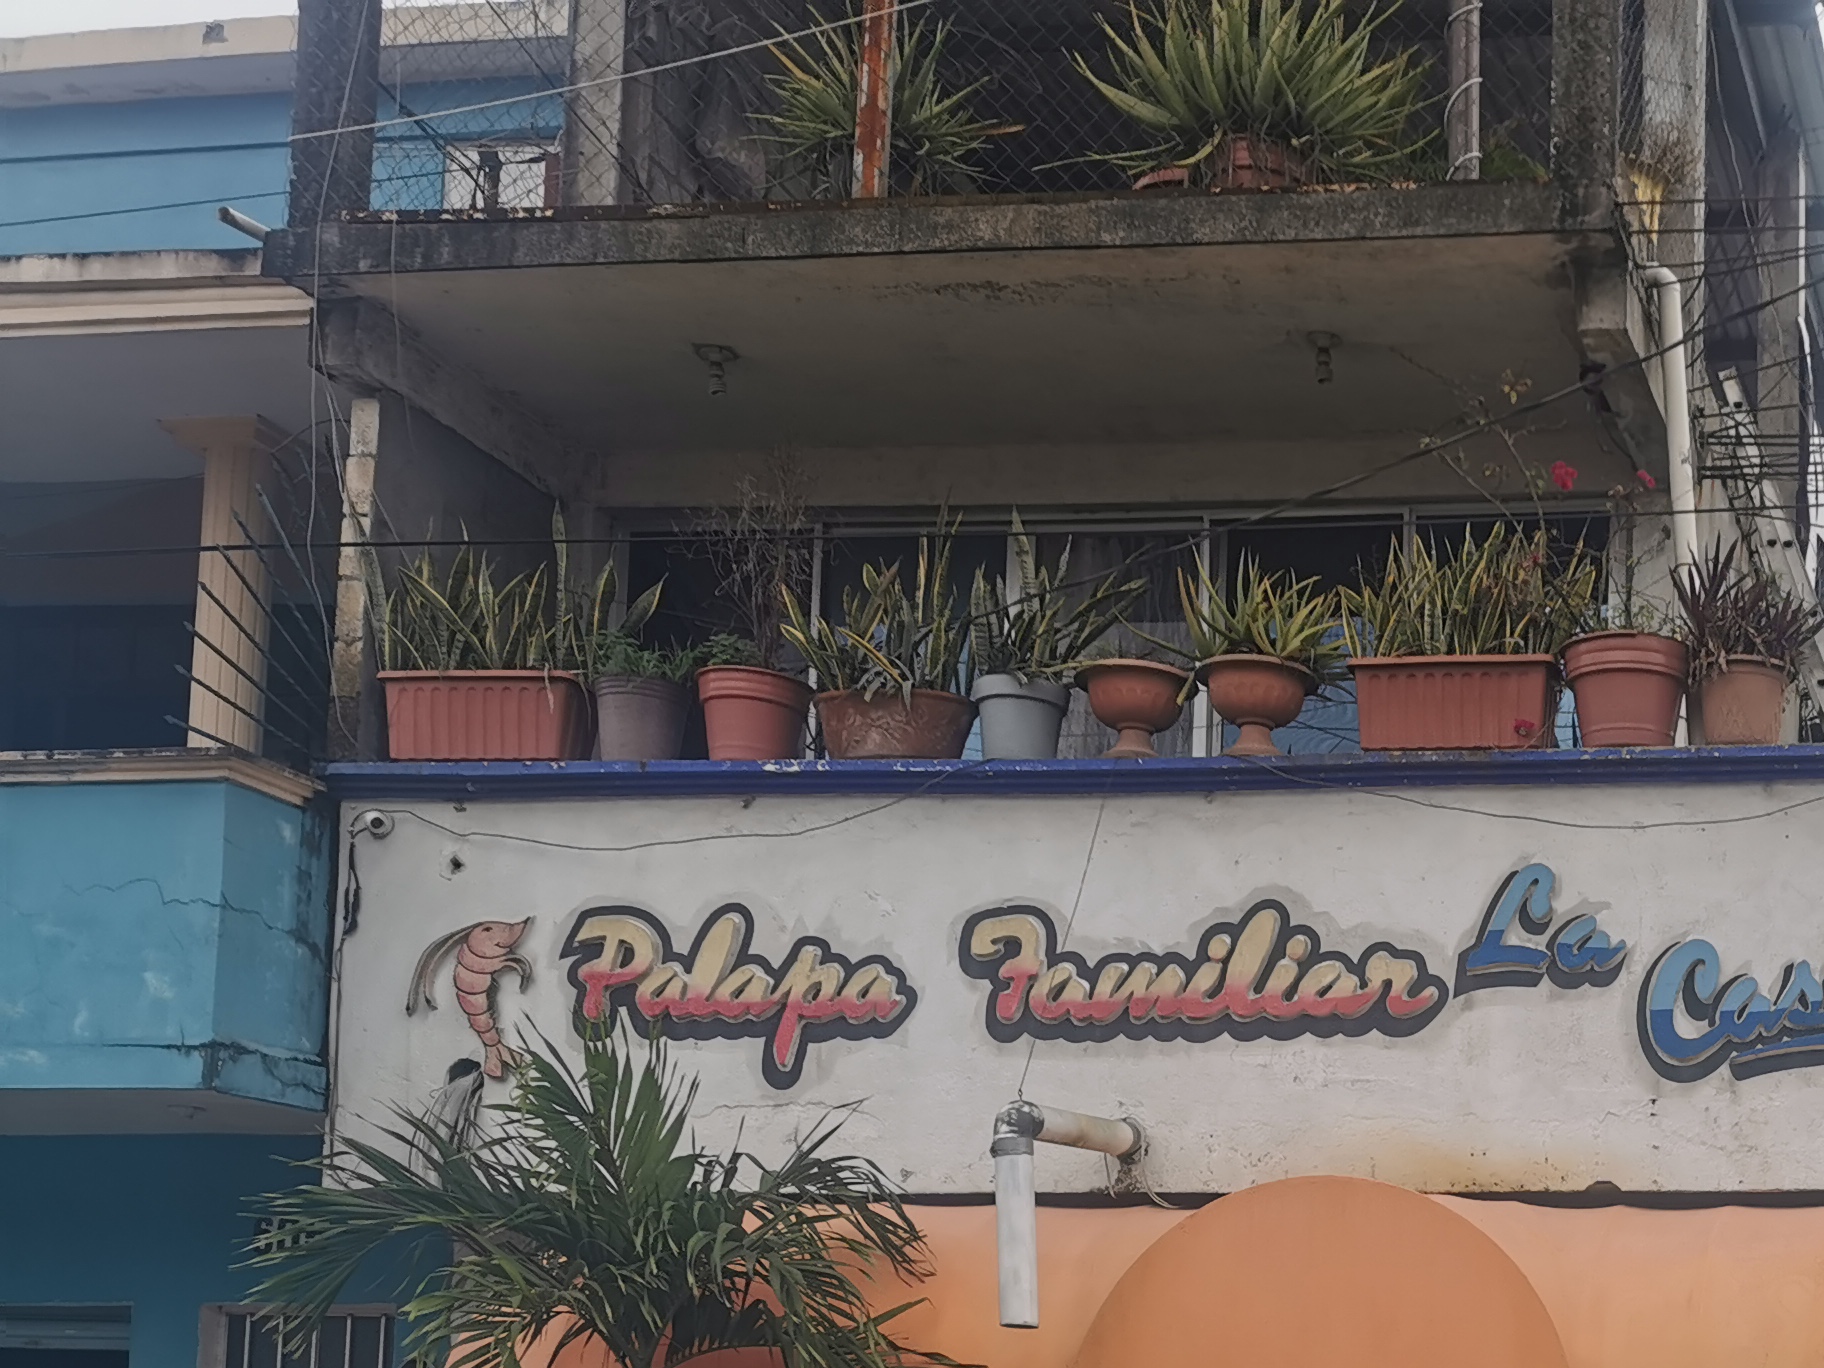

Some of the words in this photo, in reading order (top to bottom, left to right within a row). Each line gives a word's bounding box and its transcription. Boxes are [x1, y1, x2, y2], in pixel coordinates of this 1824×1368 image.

[560, 903, 917, 1090] Palapa
[959, 898, 1449, 1043] Familiar
[1454, 862, 1627, 998] La
